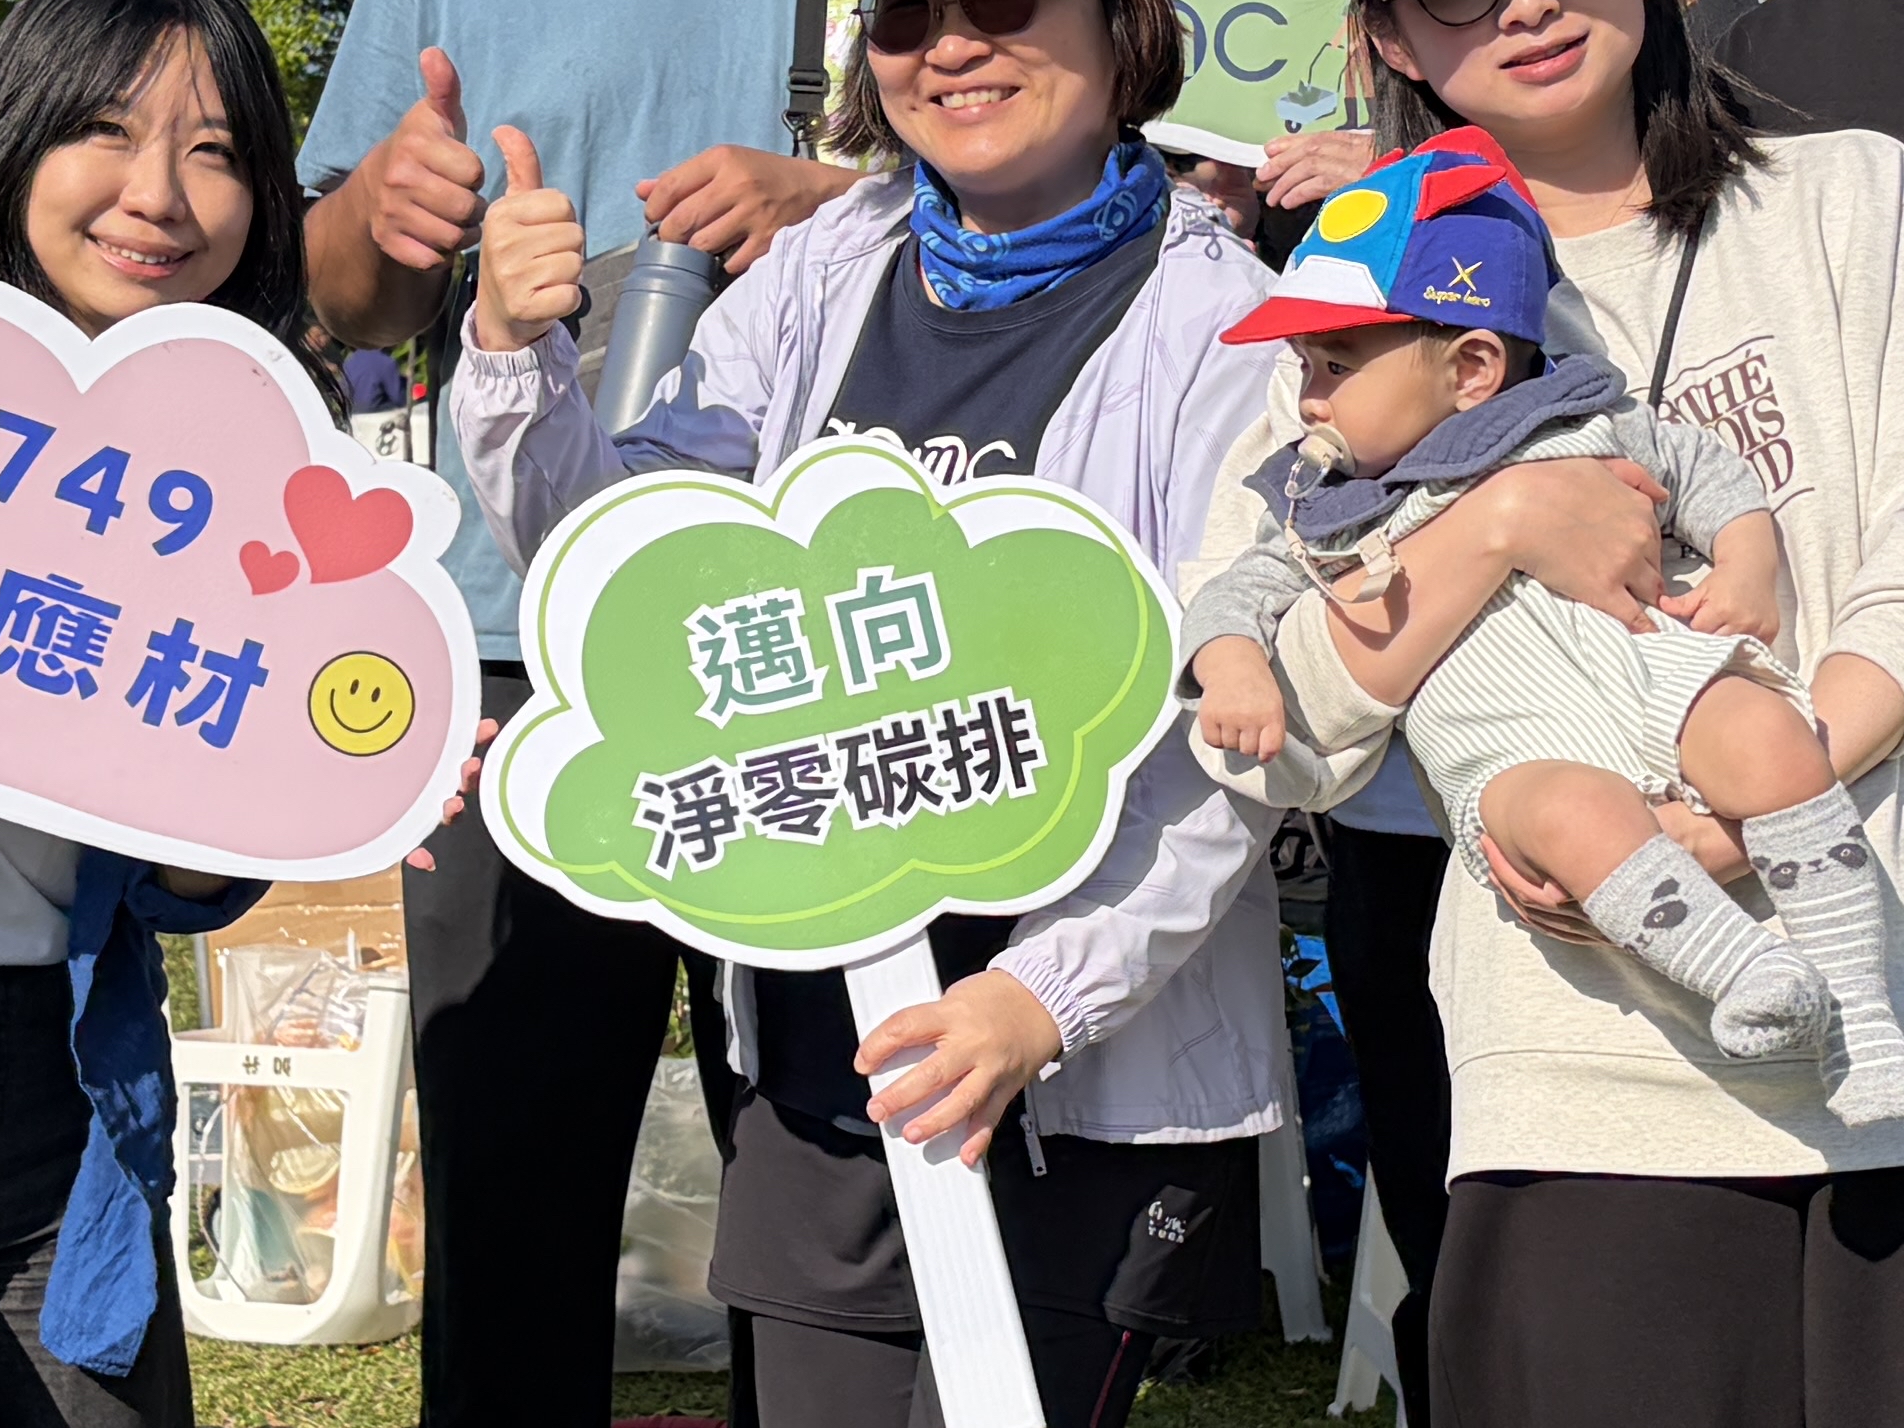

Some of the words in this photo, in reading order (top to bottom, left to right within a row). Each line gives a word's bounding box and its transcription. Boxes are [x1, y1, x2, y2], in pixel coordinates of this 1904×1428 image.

[693, 573, 949, 718] 邁向
[639, 697, 1038, 870] 淨零碳排
